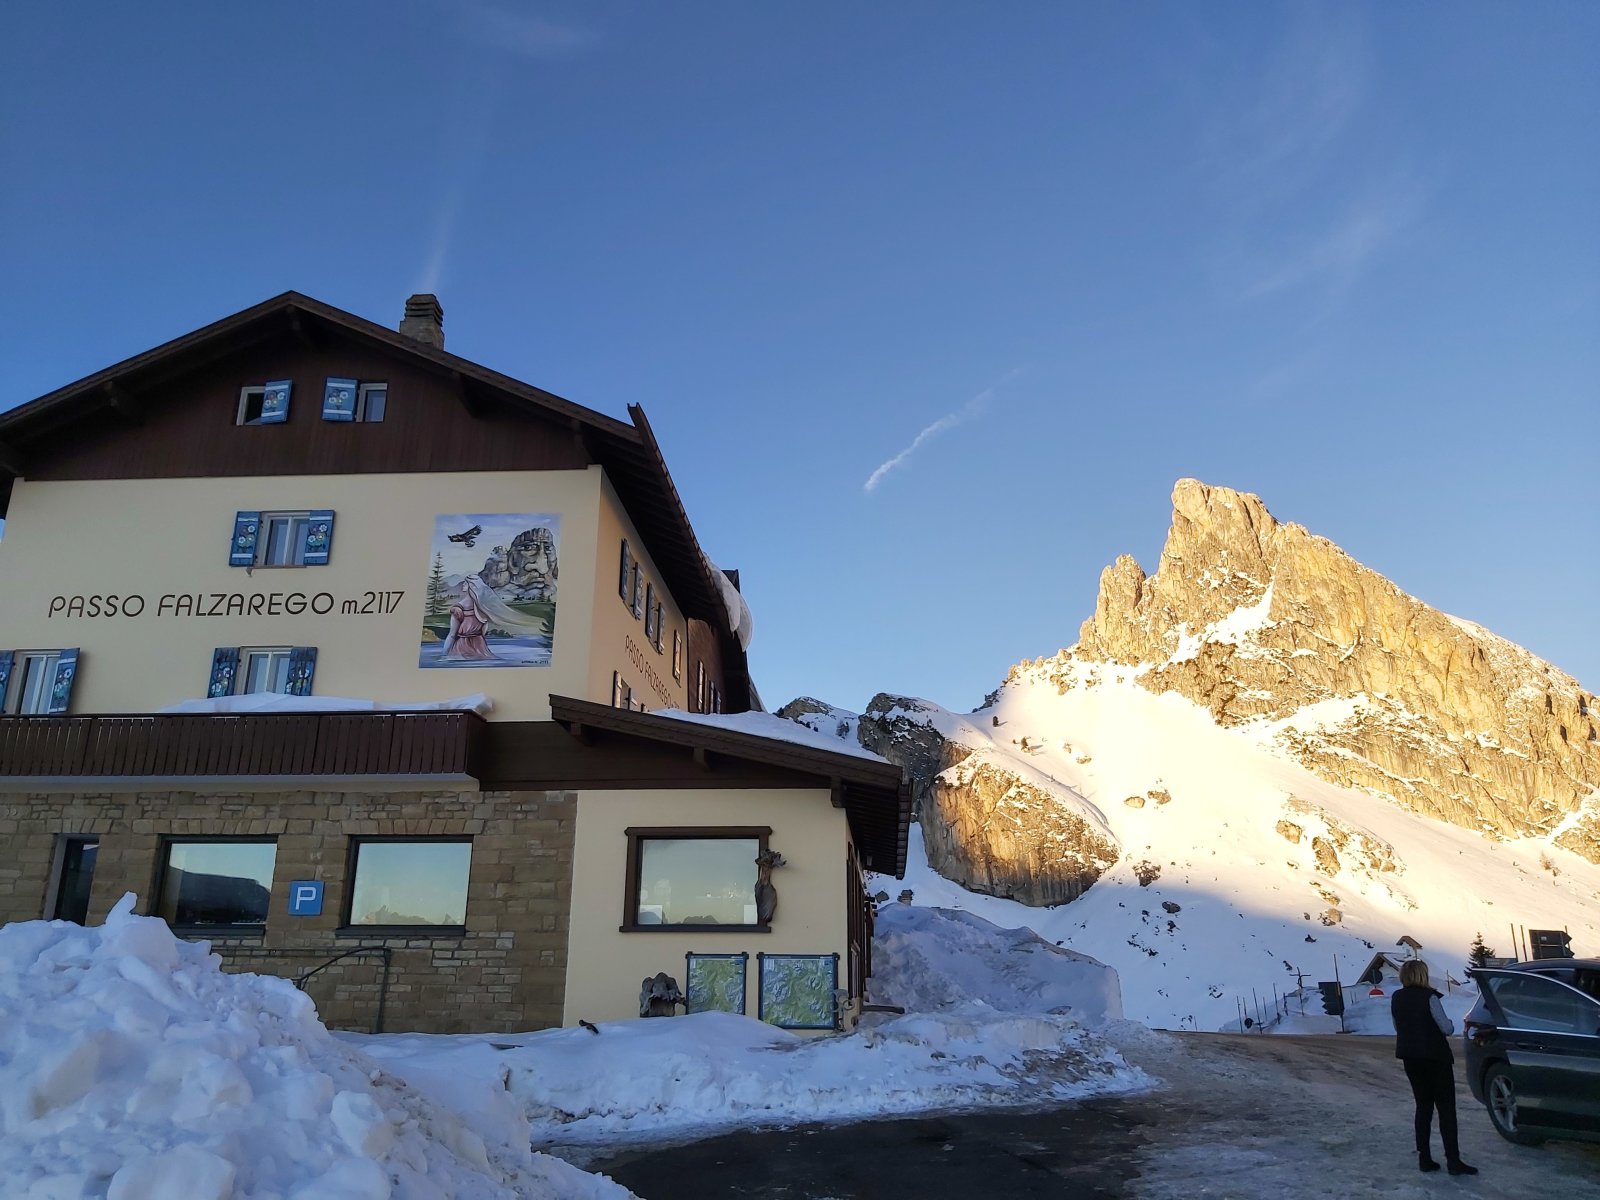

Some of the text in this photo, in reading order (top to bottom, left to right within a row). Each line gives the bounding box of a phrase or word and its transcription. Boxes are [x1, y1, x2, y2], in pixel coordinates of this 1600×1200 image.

[48, 591, 405, 618] PASSO FALZAREGO m.2117
[625, 634, 644, 673] PASSO
[295, 886, 317, 910] P
